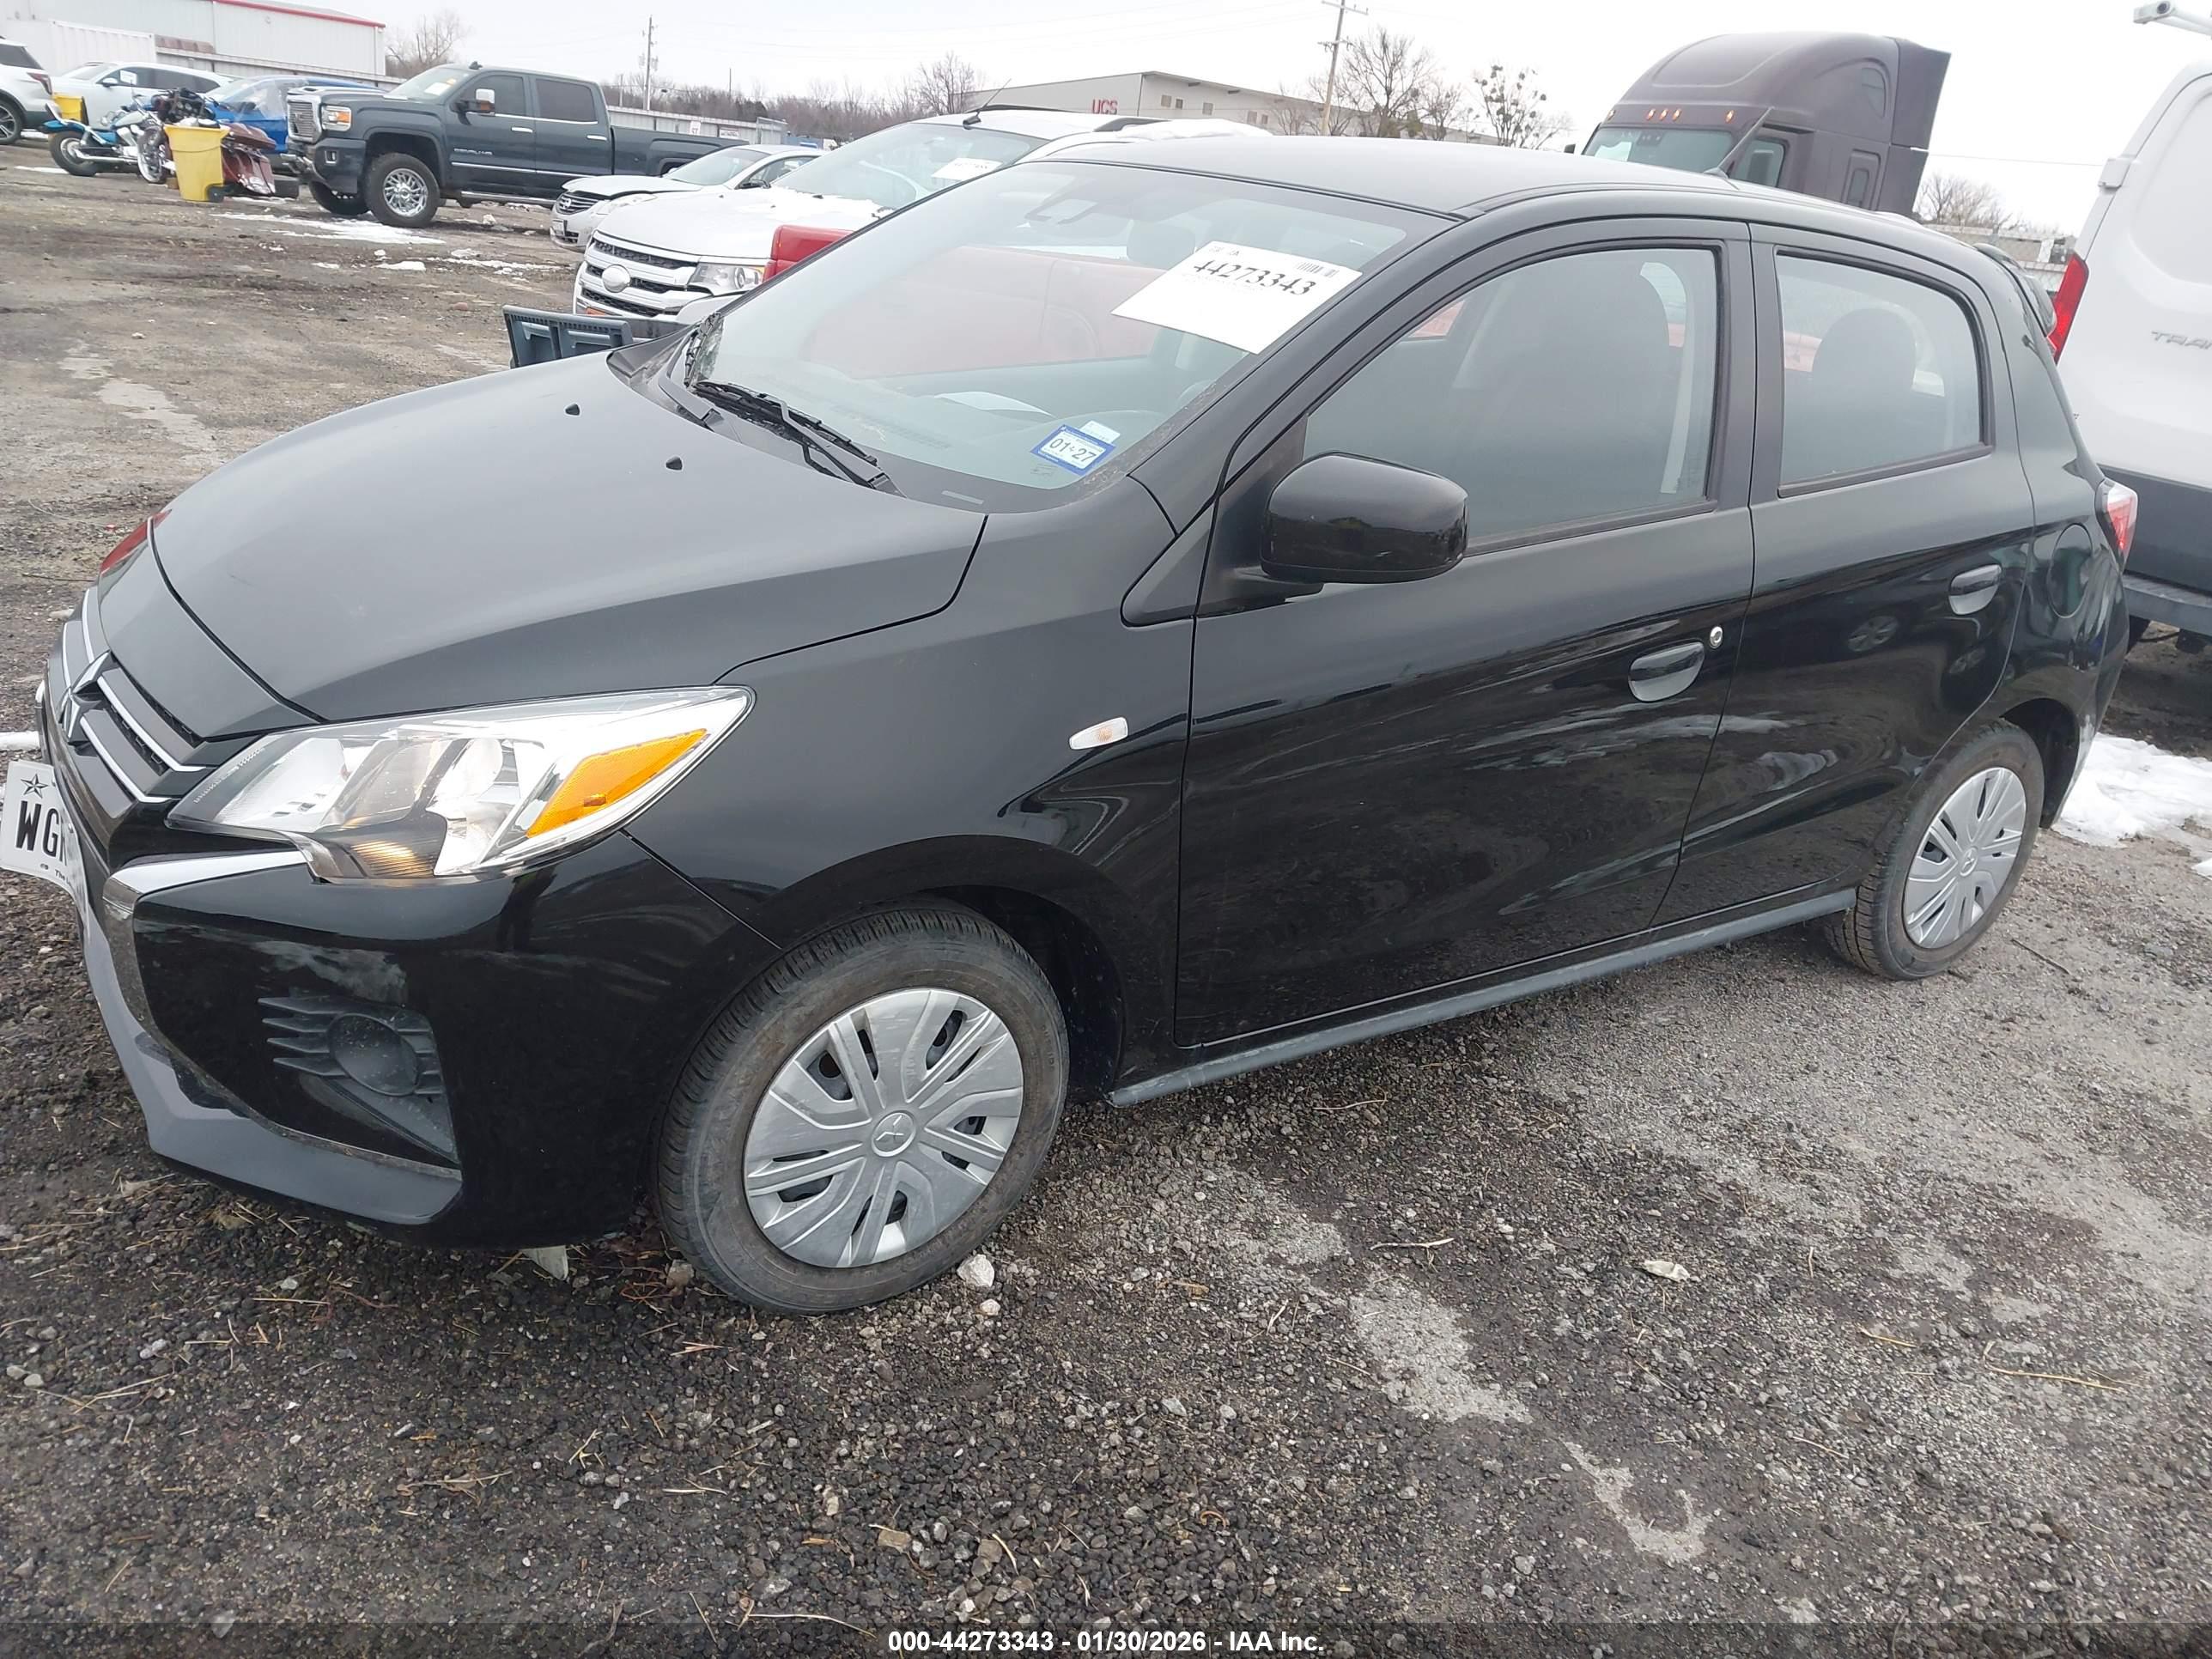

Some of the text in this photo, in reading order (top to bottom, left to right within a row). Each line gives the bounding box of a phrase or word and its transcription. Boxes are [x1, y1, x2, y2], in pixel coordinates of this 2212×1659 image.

[1092, 99, 1118, 115] UCS
[1194, 259, 1317, 295] 44273343
[15, 799, 68, 866] WG
